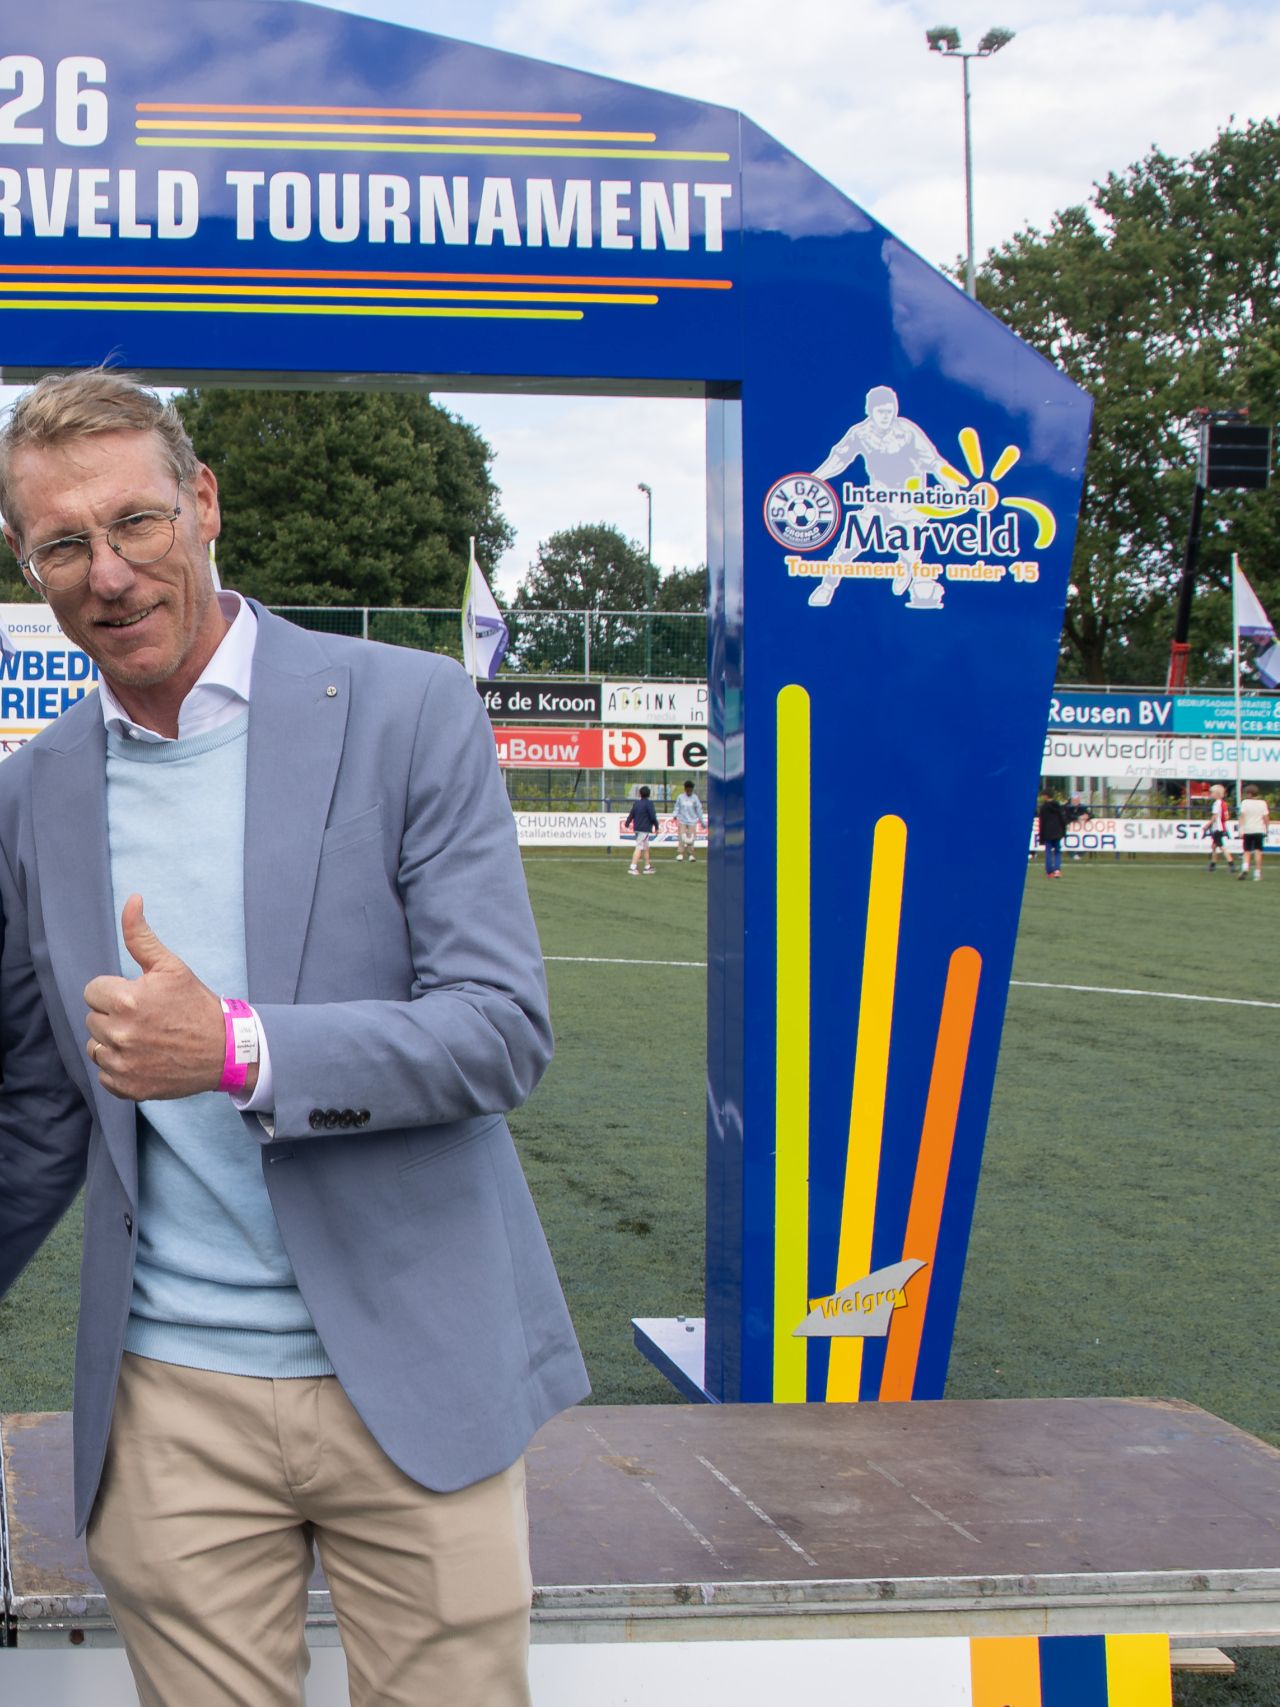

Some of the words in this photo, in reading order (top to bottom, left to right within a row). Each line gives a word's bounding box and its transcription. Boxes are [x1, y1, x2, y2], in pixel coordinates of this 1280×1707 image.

[226, 170, 732, 252] TOURNAMENT
[795, 481, 832, 518] GROL
[844, 485, 987, 506] International
[843, 513, 1020, 554] Marveld
[786, 557, 905, 578] Tournament
[911, 561, 942, 578] for
[947, 561, 1004, 580] under
[1010, 563, 1039, 582] 15
[508, 691, 532, 711] de
[538, 692, 596, 712] Kroon
[608, 692, 676, 711] ADDINK
[1048, 698, 1132, 724] Reusen
[1138, 700, 1173, 726] BV
[1043, 737, 1174, 764] Bouwbedrijf
[1180, 738, 1207, 761] de
[516, 815, 607, 828] CHUURMANS
[519, 829, 592, 839] stallatieadvies
[594, 829, 607, 839] bv
[820, 1288, 897, 1320] Welgro
